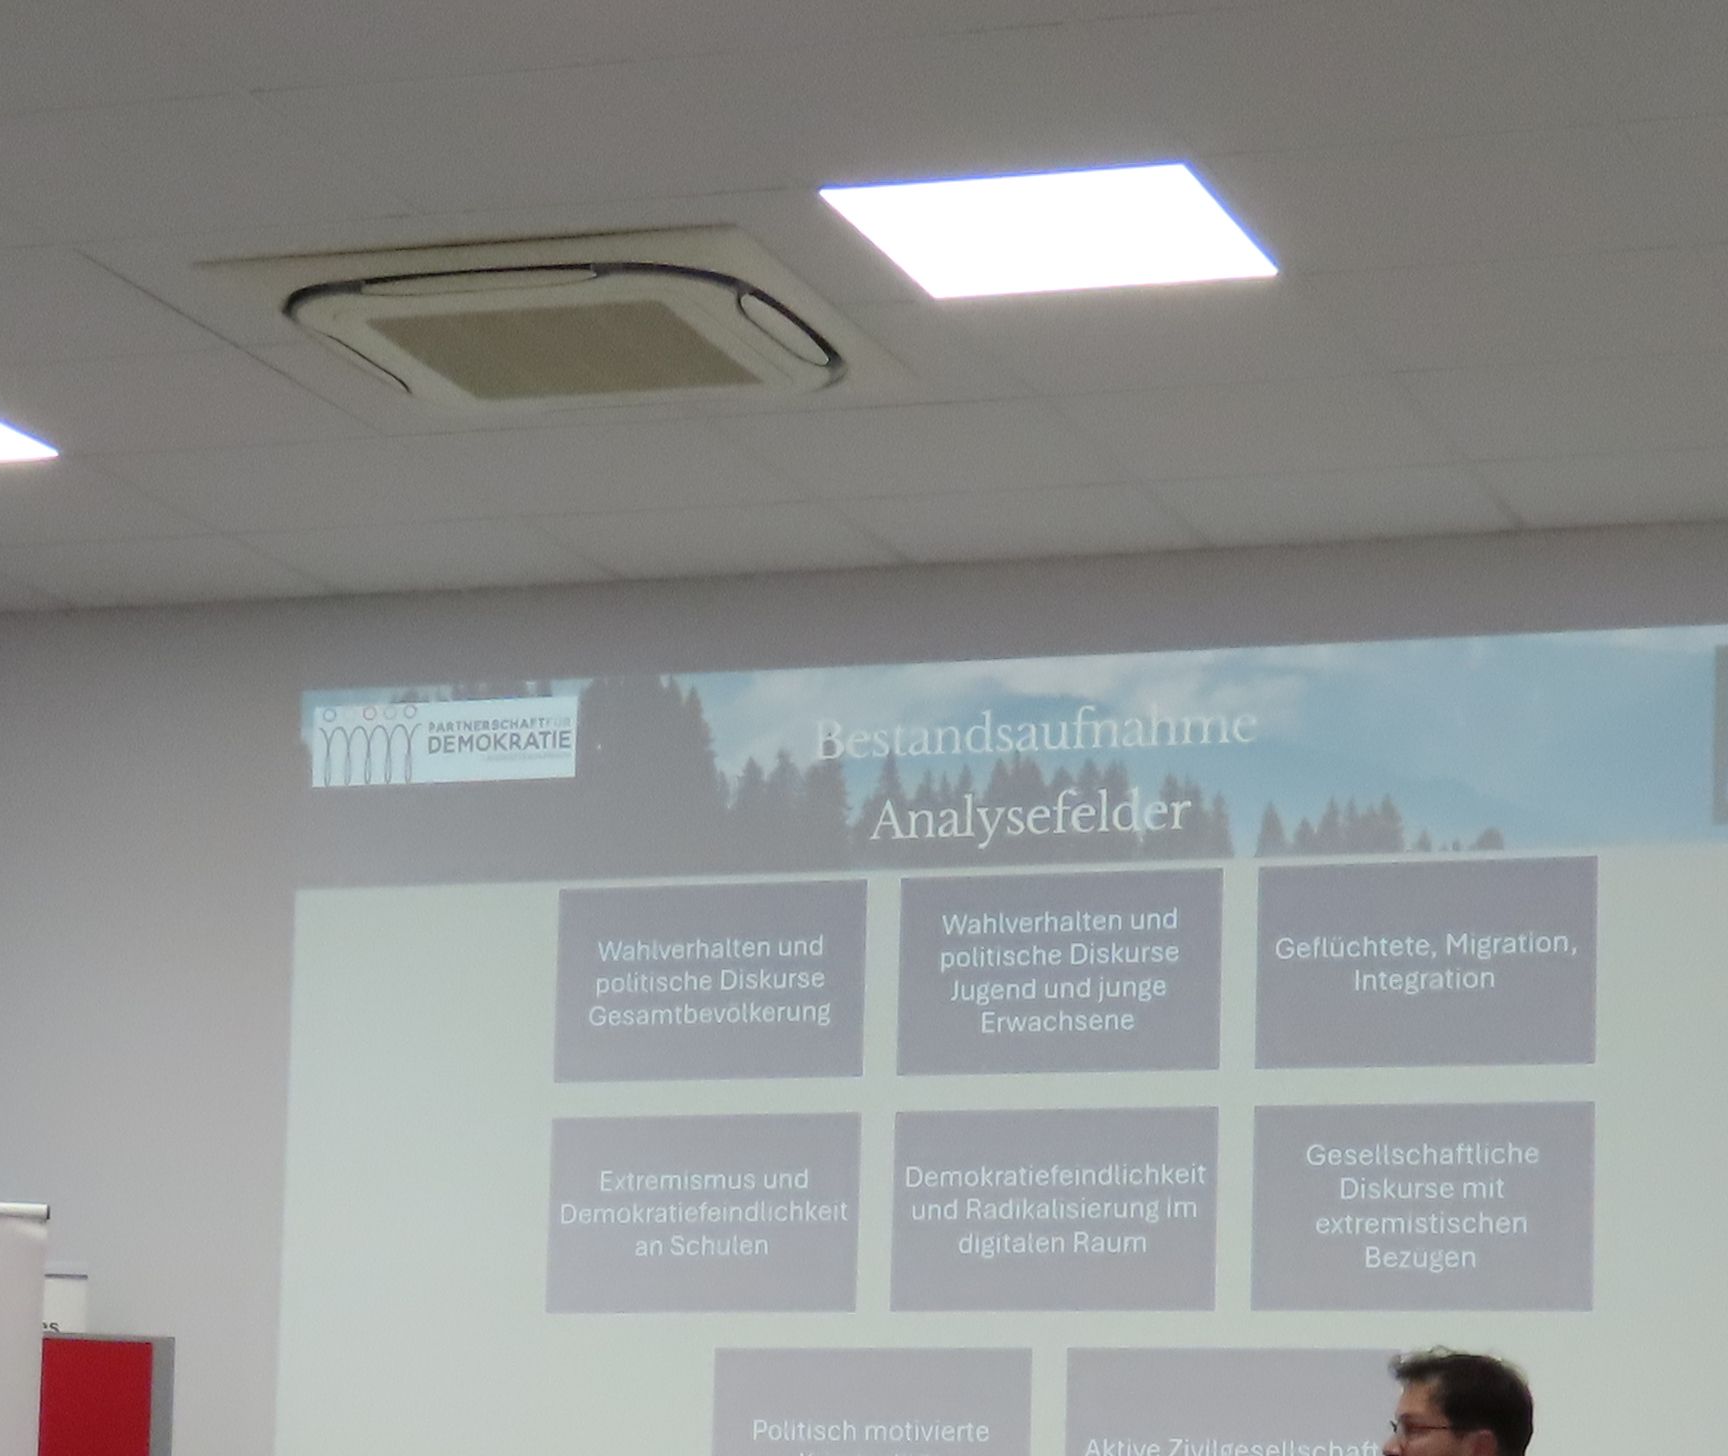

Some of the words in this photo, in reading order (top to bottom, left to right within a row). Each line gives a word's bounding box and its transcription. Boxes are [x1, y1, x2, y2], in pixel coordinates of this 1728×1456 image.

[427, 729, 573, 755] DEMOKRATIE
[815, 705, 1259, 762] Bestandsaufnahme
[869, 787, 1193, 850] Analysefelder
[941, 910, 1123, 936] Wahlverhalten
[1130, 906, 1178, 930] und
[597, 937, 771, 962] Wahlverhalten
[778, 933, 824, 957] und
[939, 944, 1063, 973] politische
[1069, 942, 1180, 965] Diskurse
[1275, 935, 1437, 960] Geflüchtete,
[1445, 932, 1577, 960] Migration,
[595, 970, 713, 998] politische
[720, 968, 826, 991] Diskurse
[950, 978, 1037, 1006] Jugend
[1044, 977, 1092, 999] und
[1097, 978, 1167, 1003] junge
[1354, 968, 1496, 996] Integration
[981, 1010, 1135, 1034] Erwachsene
[1305, 1141, 1540, 1166] Gesellschaftliche
[599, 1169, 756, 1193] Extremismus
[763, 1167, 809, 1190] und
[905, 1162, 1207, 1188] Demokratiefeindlichkeit
[1339, 1176, 1455, 1200] Diskurse
[1462, 1177, 1505, 1199] mit
[560, 1200, 848, 1225] Demokratiefeindlichkeit
[911, 1198, 959, 1221] und
[965, 1197, 1160, 1224] Radikalisierung
[1166, 1197, 1198, 1218] im
[1315, 1211, 1528, 1235] extremistischen
[634, 1239, 663, 1257] an
[670, 1234, 769, 1257] Schulen
[957, 1232, 1066, 1260] digitalen
[1073, 1230, 1147, 1253] Raum
[752, 1418, 857, 1442] Politisch
[864, 1421, 990, 1443] motivierte
